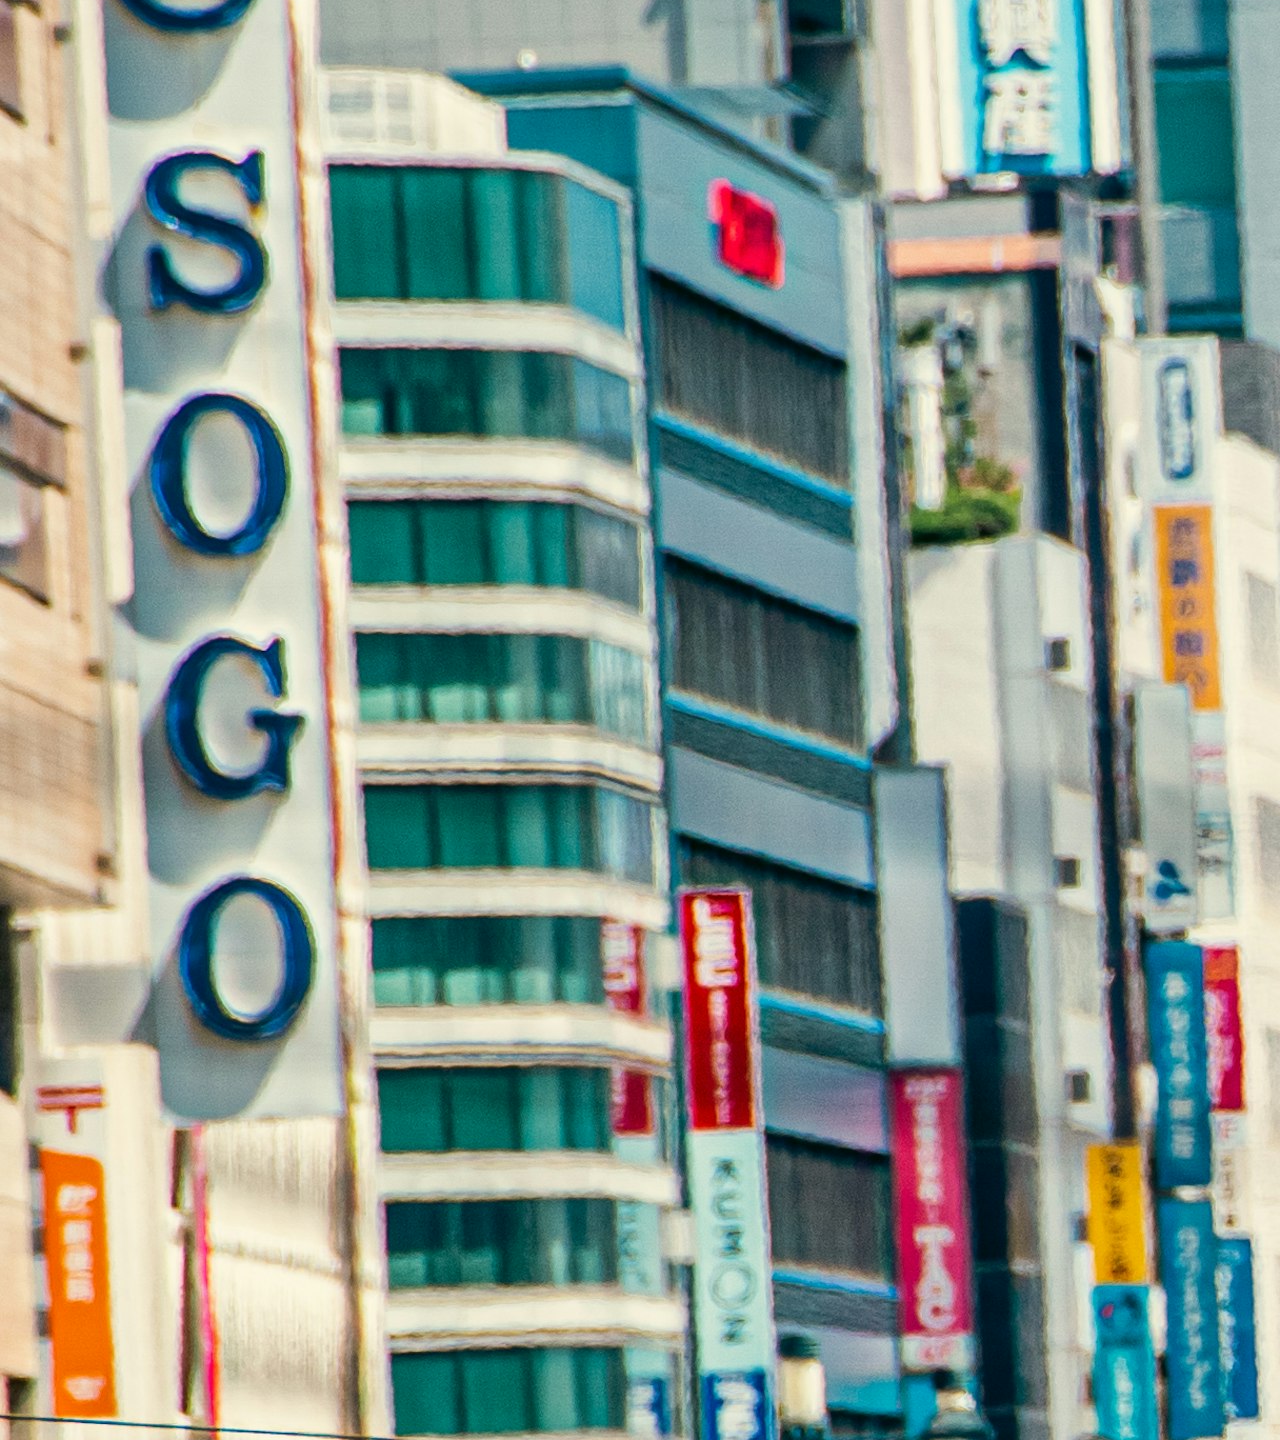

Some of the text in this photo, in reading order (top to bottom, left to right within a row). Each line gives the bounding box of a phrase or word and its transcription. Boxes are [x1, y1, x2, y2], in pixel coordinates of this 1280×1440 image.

[144, 148, 318, 1042] SOGO
[708, 1157, 758, 1347] KUMON
[913, 1226, 956, 1330] TAC
